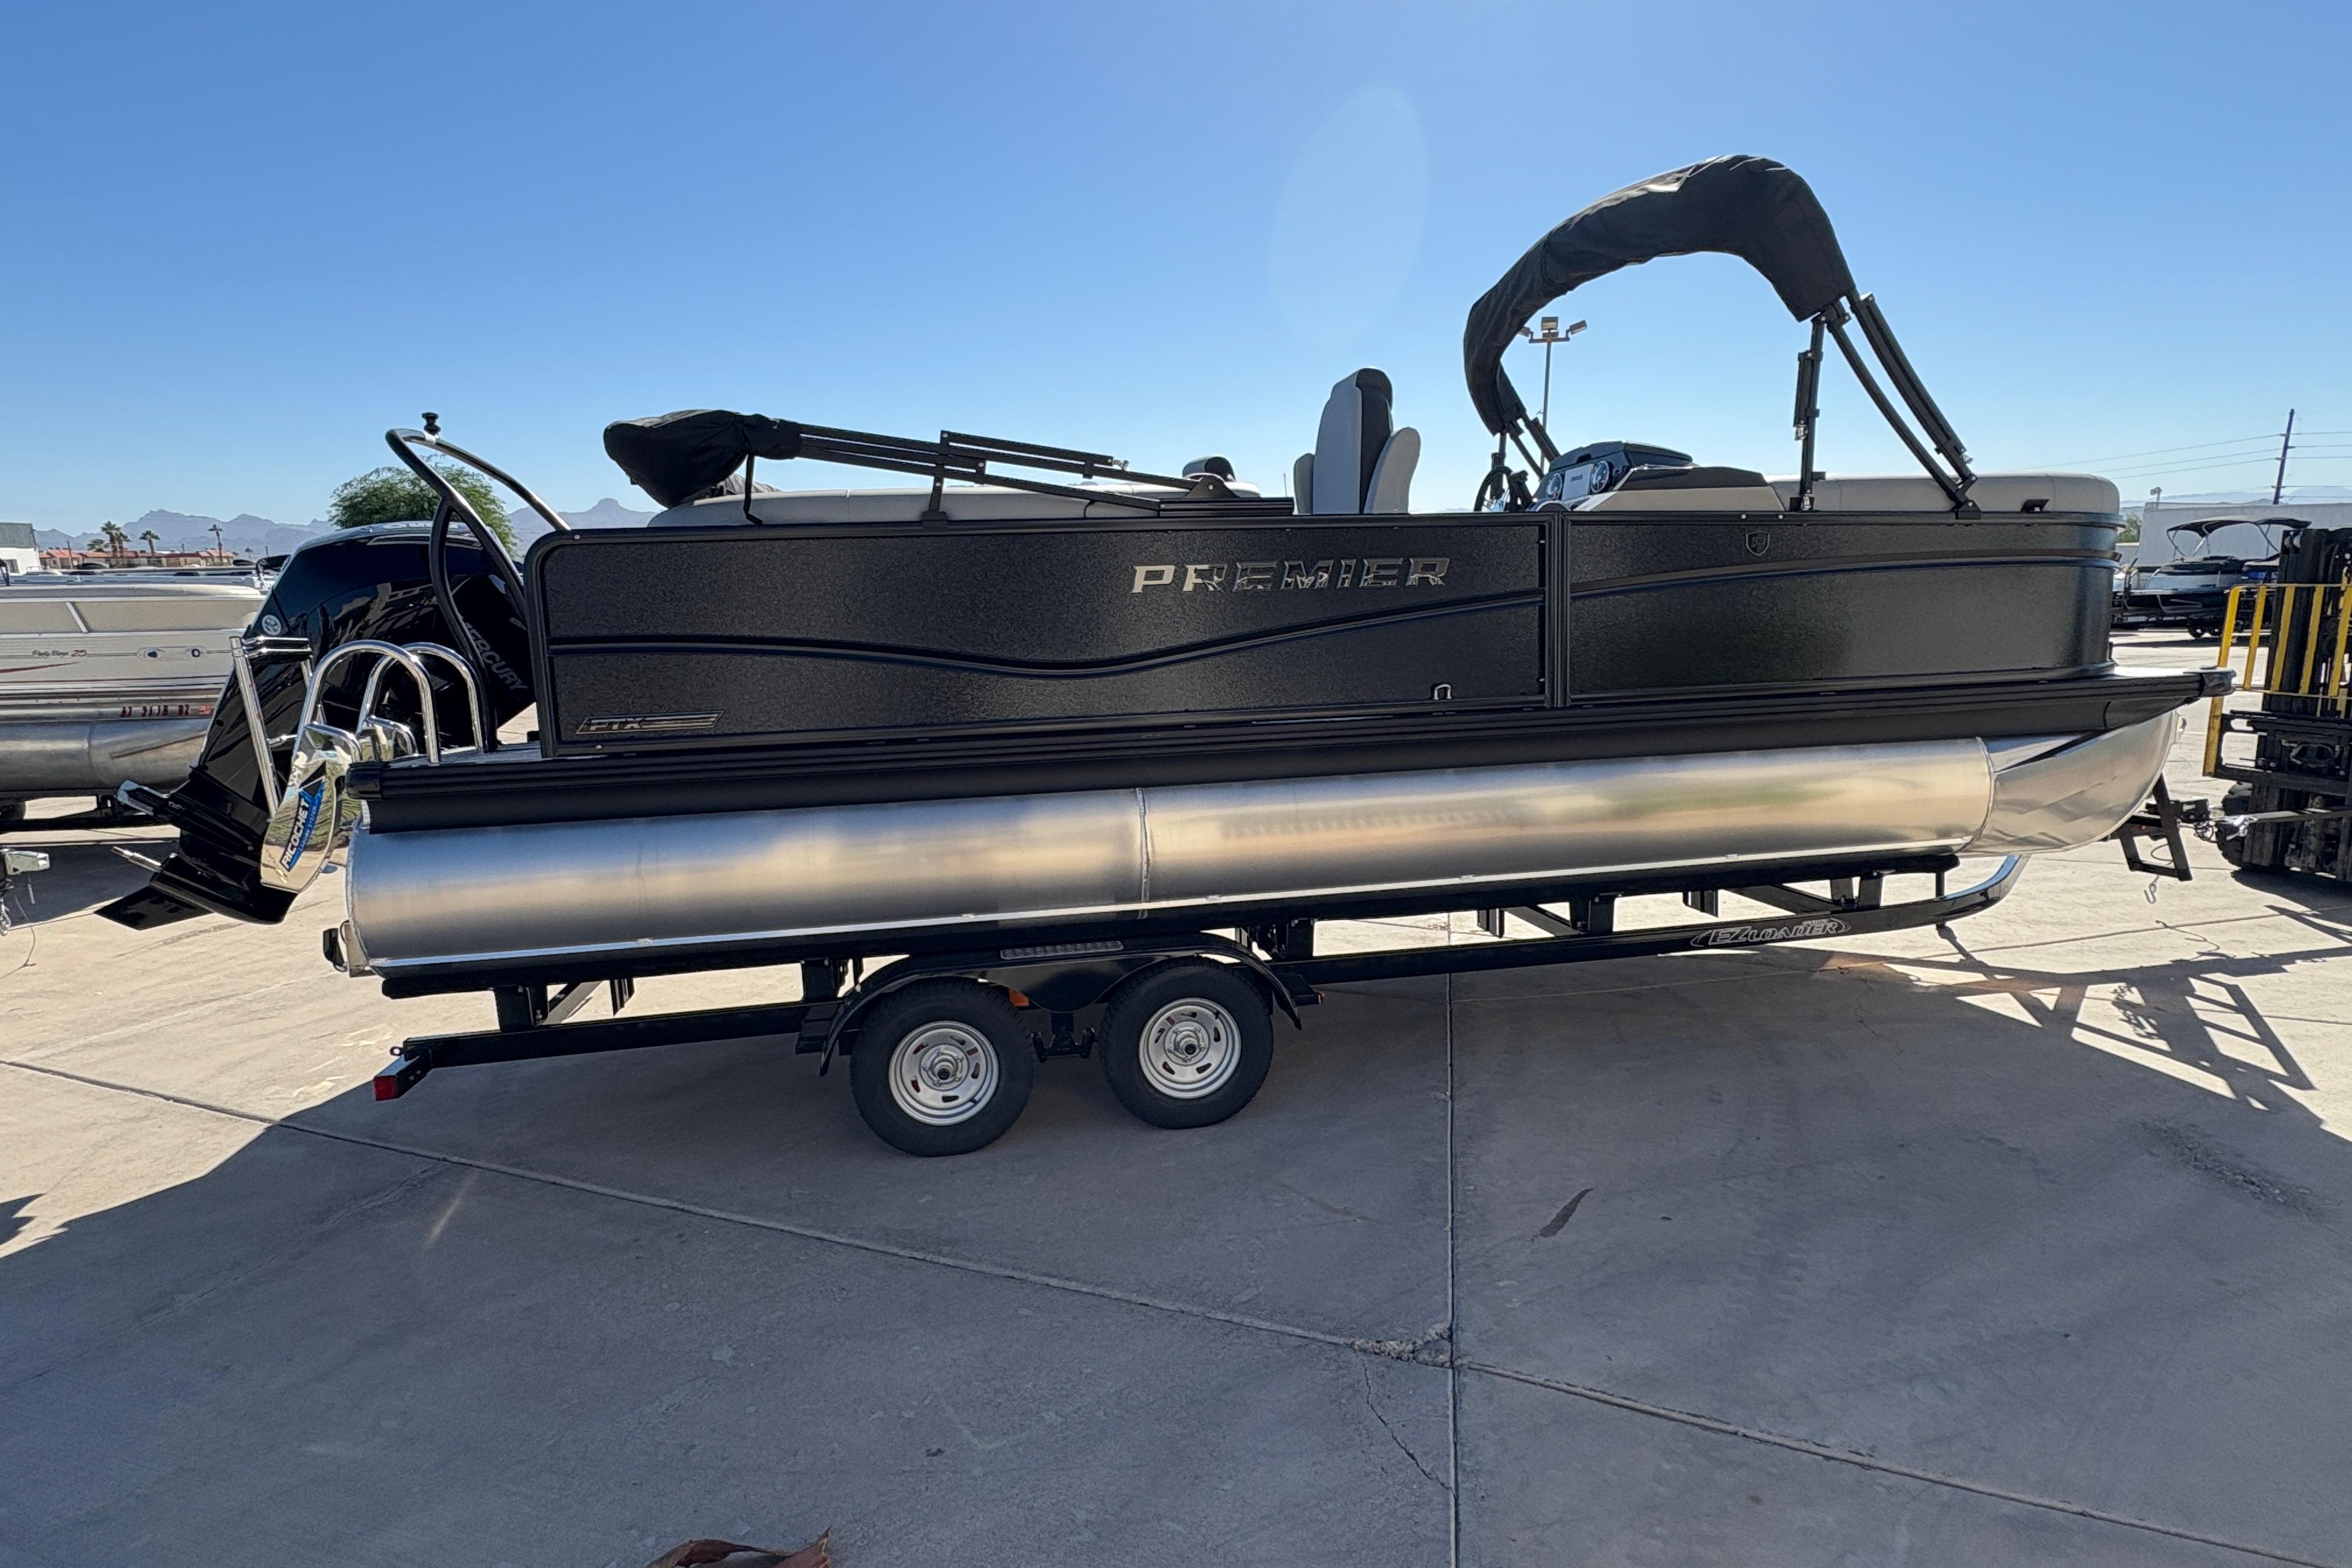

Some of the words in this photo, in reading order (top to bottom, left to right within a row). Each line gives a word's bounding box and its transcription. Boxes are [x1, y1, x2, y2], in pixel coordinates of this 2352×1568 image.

[1131, 557, 1450, 594] PREMIER
[461, 615, 528, 690] ERCURY
[588, 716, 643, 731] PTX
[281, 797, 310, 869] RICOCHET
